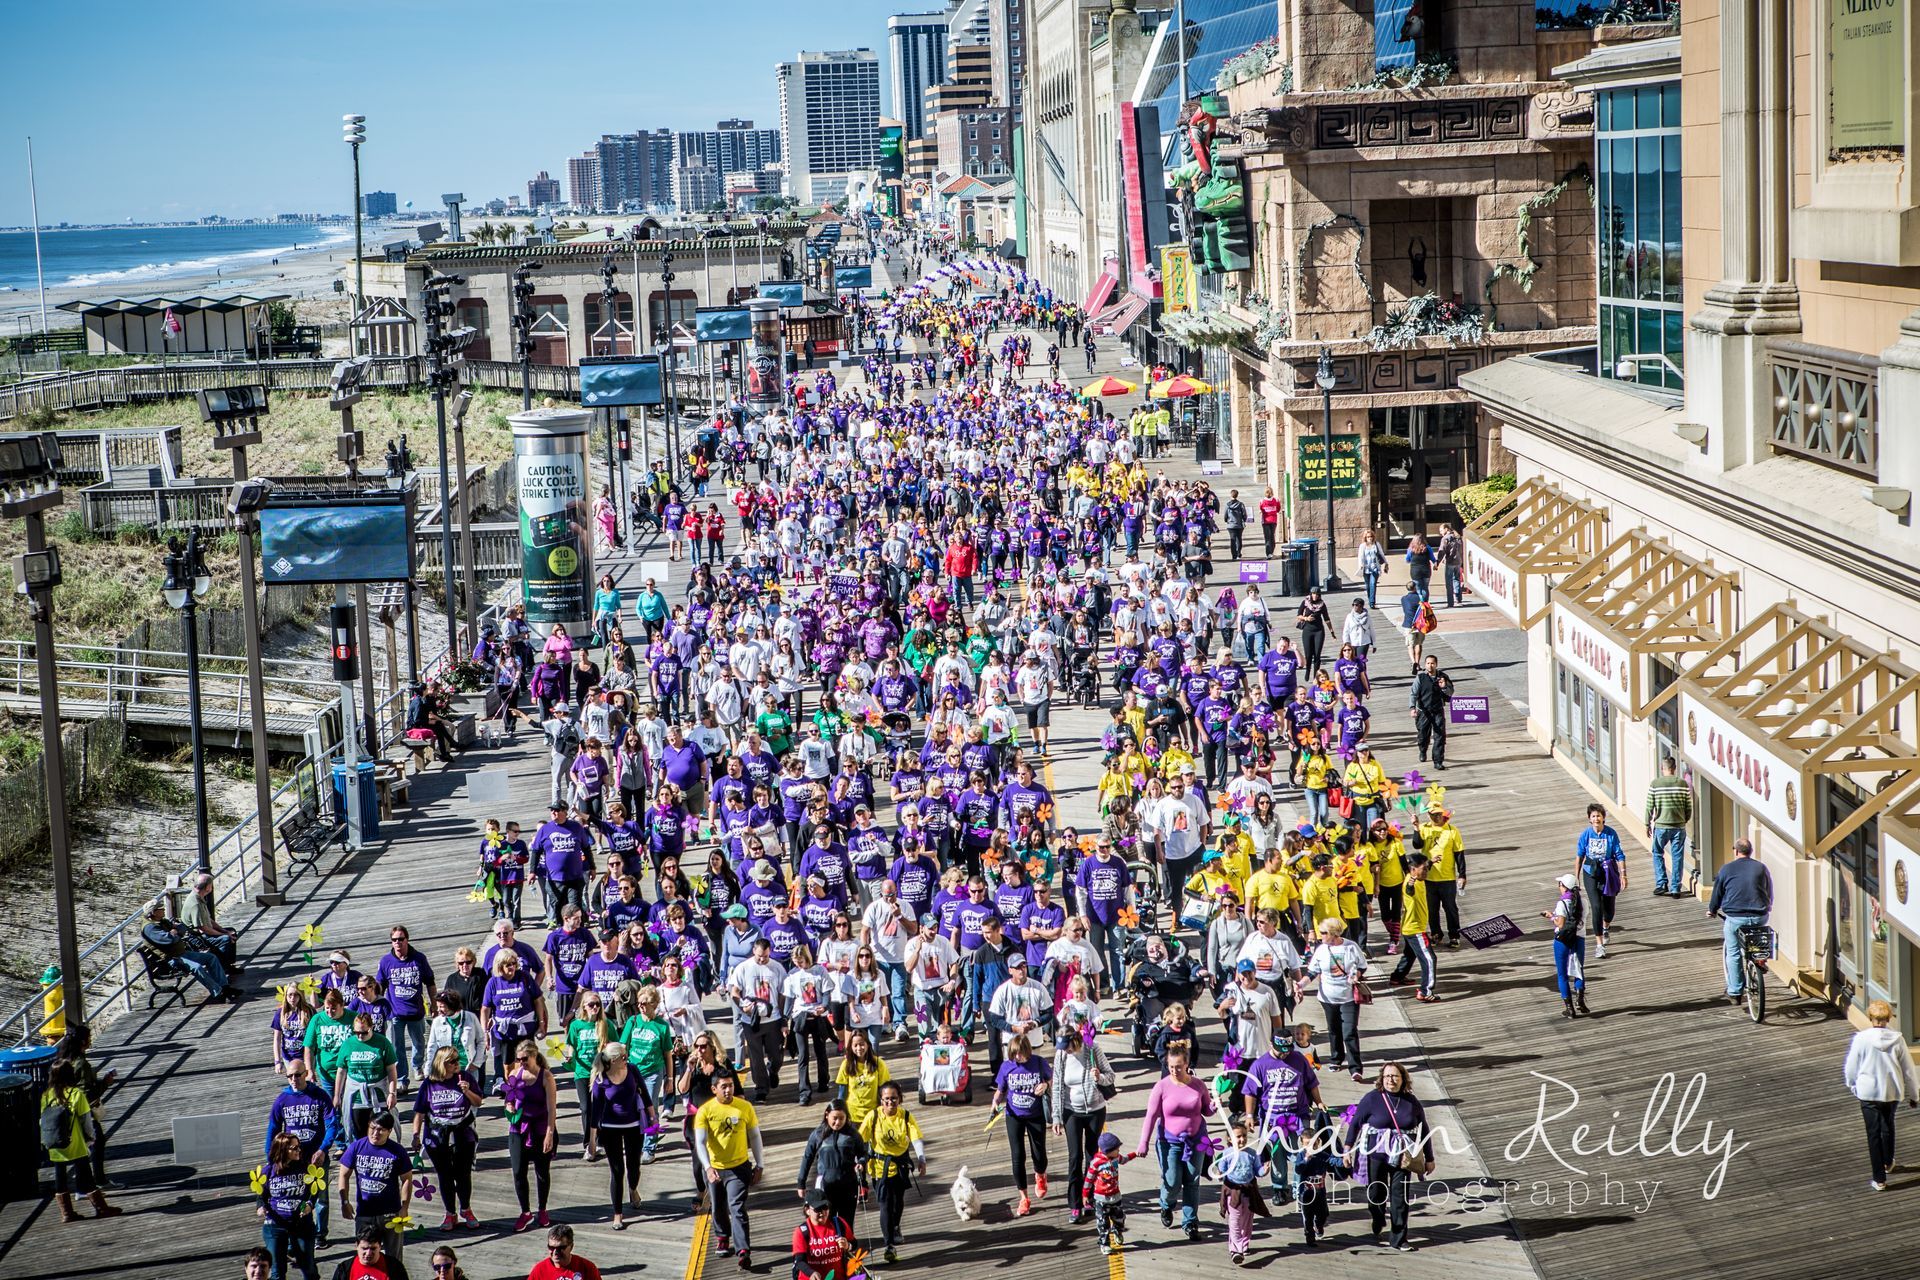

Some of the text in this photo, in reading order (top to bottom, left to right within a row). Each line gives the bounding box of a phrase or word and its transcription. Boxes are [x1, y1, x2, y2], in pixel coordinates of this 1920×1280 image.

[1844, 21, 1891, 40] ITALIAN STEAKHOUSE
[528, 465, 572, 476] CAUTION:
[1305, 469, 1355, 479] OPEN!
[523, 476, 576, 487] LUCK COULD
[522, 487, 582, 498] STRIKE TWICE.
[1478, 558, 1506, 599] CAESARS
[830, 585, 858, 596] ARMY
[1571, 626, 1611, 680] CAESARS
[1708, 726, 1771, 802] CAESARS
[824, 1234, 841, 1244] you
